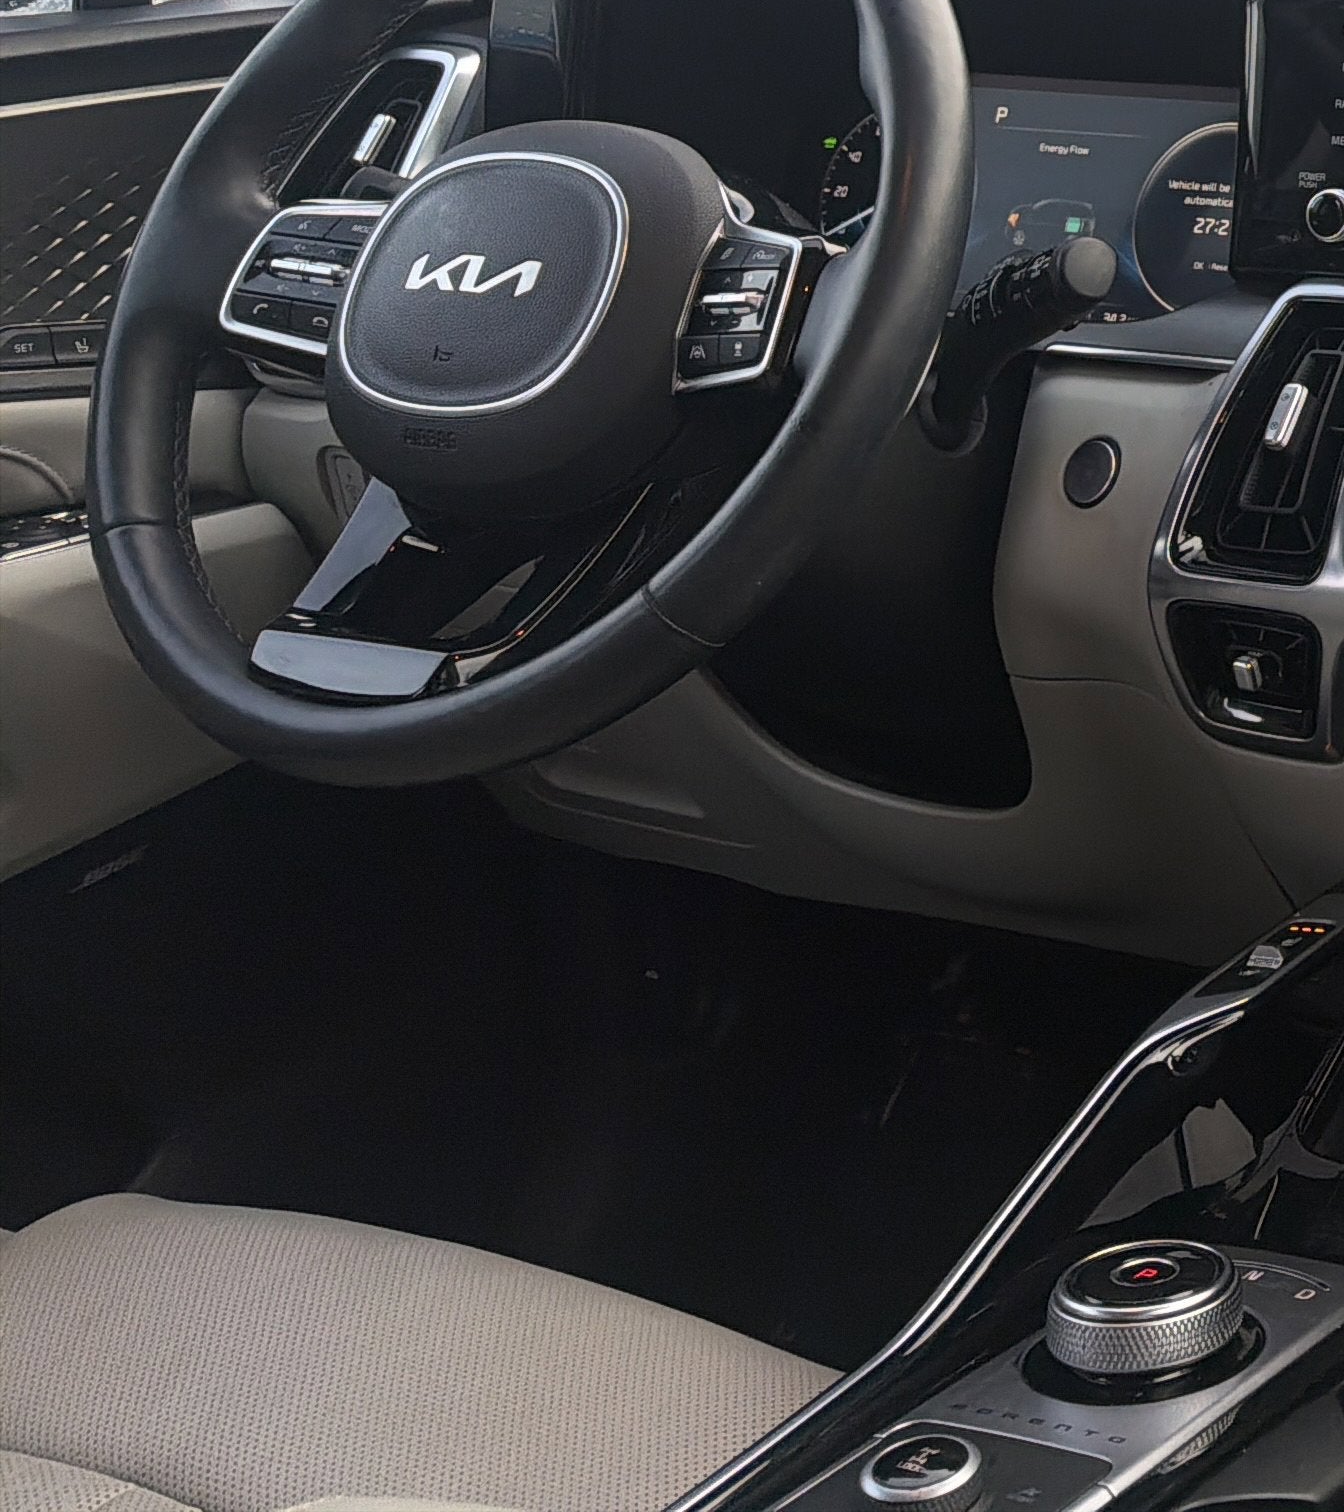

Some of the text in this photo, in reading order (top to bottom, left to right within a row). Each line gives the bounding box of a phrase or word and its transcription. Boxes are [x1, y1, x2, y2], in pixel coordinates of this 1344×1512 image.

[995, 106, 1009, 123] P
[1039, 143, 1090, 156] Energy Flow
[1298, 171, 1326, 182] POWER
[1168, 179, 1231, 193] Vehicle will be
[1298, 180, 1318, 189] PUSH
[833, 185, 848, 198] 20
[1193, 261, 1204, 270] OK
[404, 253, 543, 298] KIA
[13, 342, 34, 354] SET
[1132, 1267, 1159, 1280] P
[1241, 1269, 1265, 1281] N
[1293, 1288, 1317, 1300] D
[951, 1402, 1127, 1445] SORENTO
